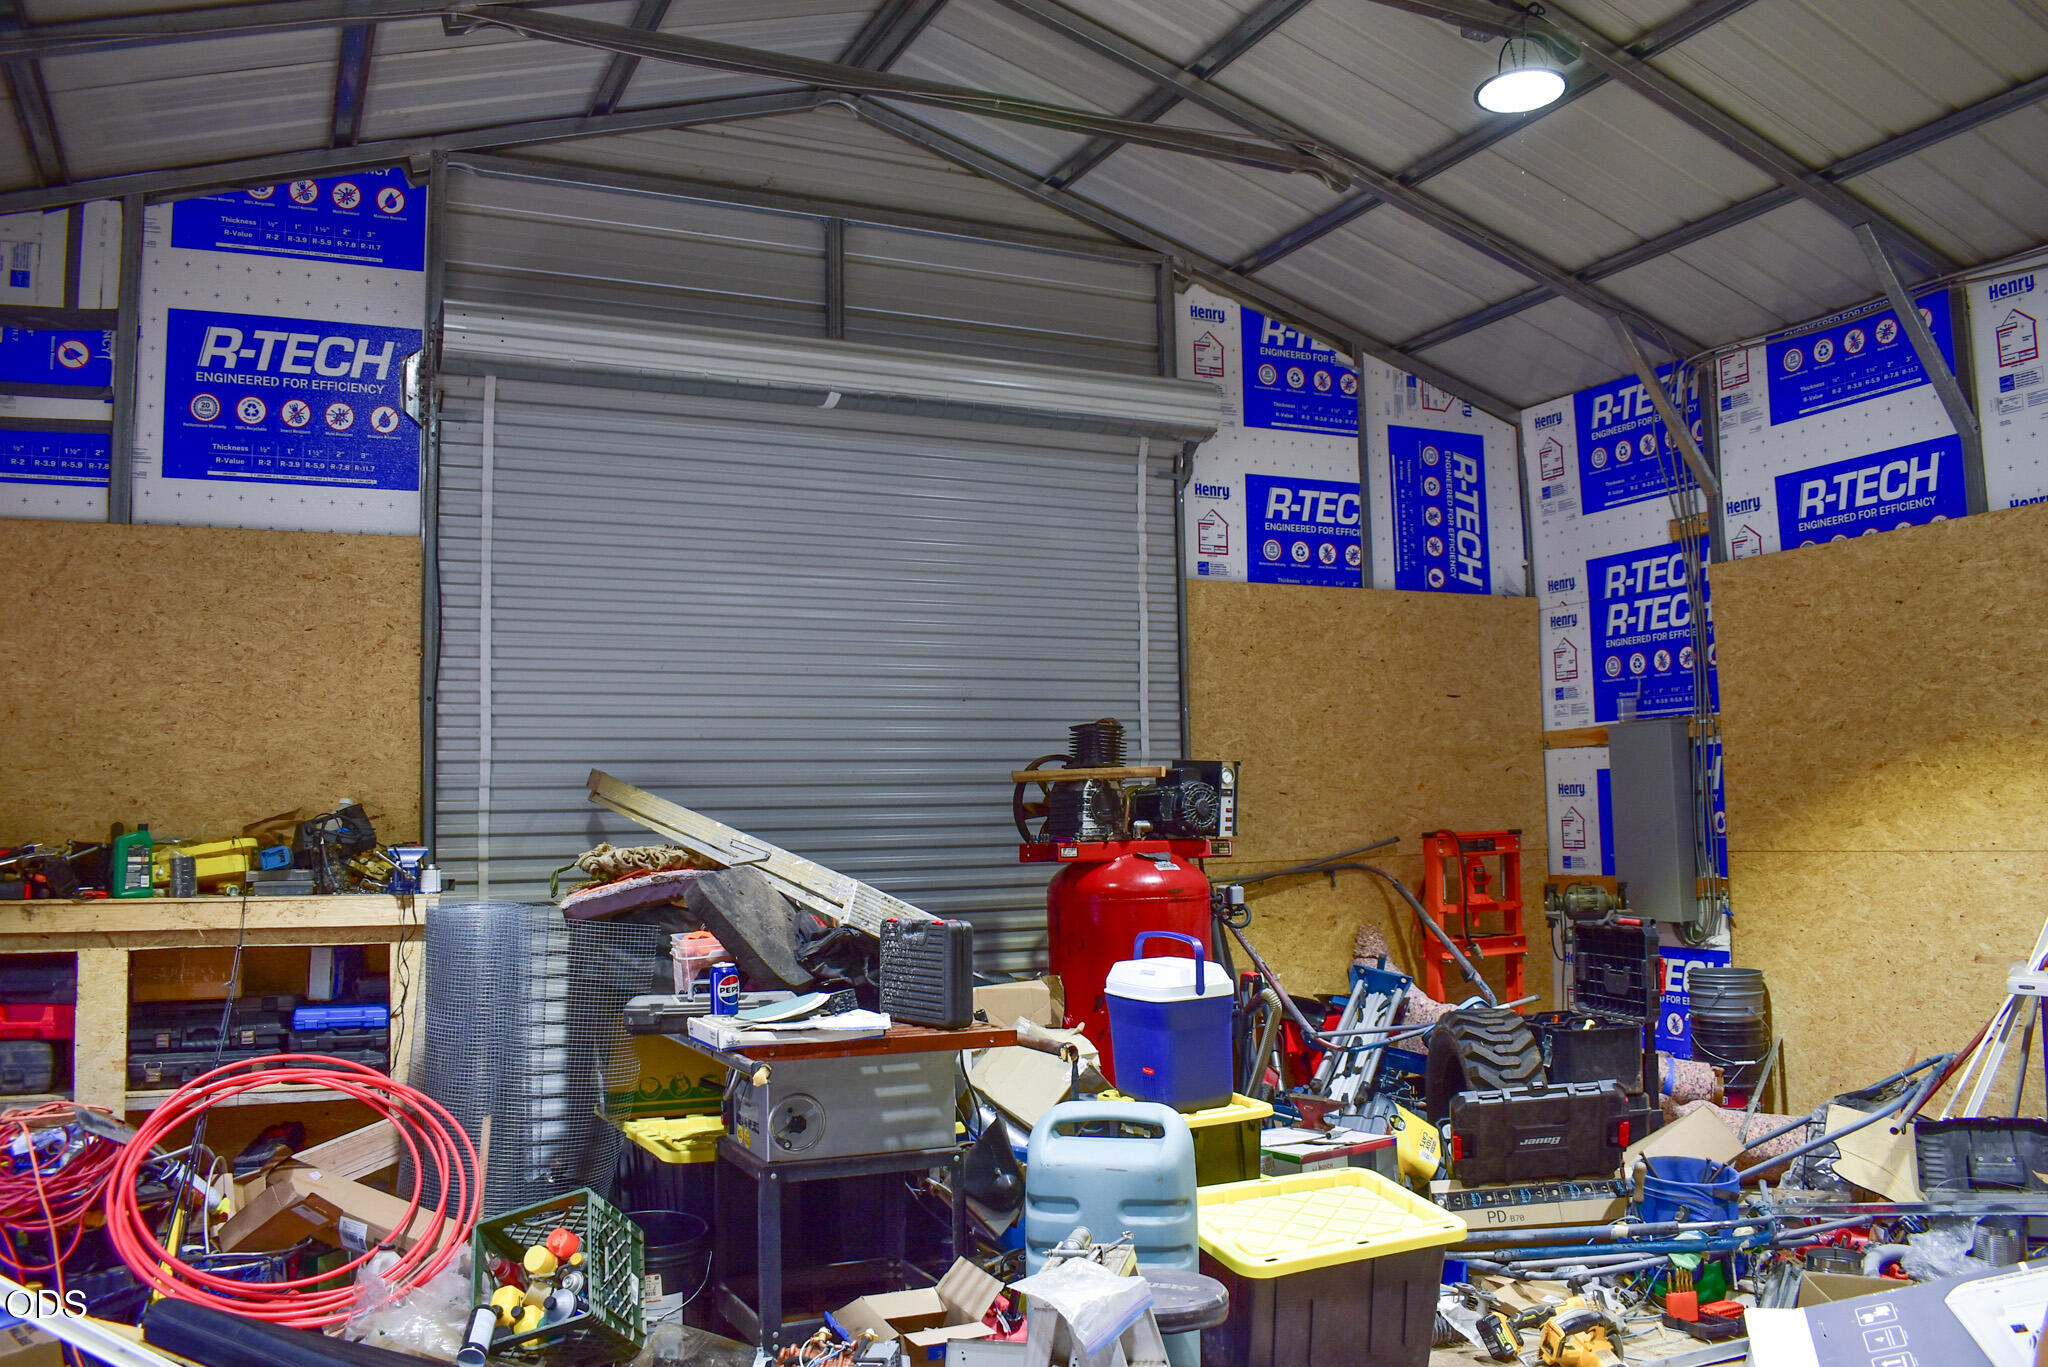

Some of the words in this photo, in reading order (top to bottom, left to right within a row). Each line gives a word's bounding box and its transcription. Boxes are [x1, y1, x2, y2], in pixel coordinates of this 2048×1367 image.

[221, 216, 257, 226] Thickness
[223, 229, 253, 239] R-Value
[266, 233, 279, 241] R-2
[287, 235, 307, 244] R-3.9
[312, 237, 332, 246] R-5.9
[336, 240, 356, 249] R-7.8
[360, 242, 381, 251] R-11.7
[1988, 274, 2035, 300] Henry
[1190, 305, 1225, 323] Henry
[197, 326, 395, 381] R-TECH
[1260, 347, 1311, 361] ENGINEERED
[1312, 353, 1329, 362] FOR
[195, 371, 279, 387] ENGINEERED
[283, 377, 309, 389] FOR
[312, 380, 385, 395] EFFICIENCY
[1534, 411, 1562, 429] Henry
[1591, 421, 1637, 441] ENGINEERED
[1637, 417, 1652, 428] FOR
[212, 443, 249, 452] Thickness
[88, 462, 110, 470] R-7.8
[215, 456, 245, 465] R-Value
[280, 460, 300, 468] R-3.9
[330, 463, 350, 471] R-7.8
[1444, 450, 1454, 507] ENGINEERED
[1798, 452, 1940, 520] R-TECH
[1194, 483, 1230, 500] Henry
[1265, 487, 1361, 526] R-TEC
[1726, 496, 1761, 515] Henry
[1798, 512, 1856, 532] ENGINEERED
[1858, 507, 1877, 521] FOR
[1879, 496, 1936, 517] EFFICIENCY
[1447, 508, 1455, 526] FOR
[1453, 451, 1483, 587] R-TECH
[1265, 522, 1317, 534] ENGINEERED
[1318, 526, 1334, 535] FOR
[1448, 527, 1458, 579] EFFICIENCY
[1547, 577, 1575, 592] Henry
[1550, 613, 1577, 629] Henry
[1606, 634, 1652, 648] ENGINEERED
[1652, 632, 1668, 641] FOR
[1558, 783, 1585, 797] Henry
[1666, 995, 1681, 1004] FOR
[1487, 1210, 1507, 1223] PD
